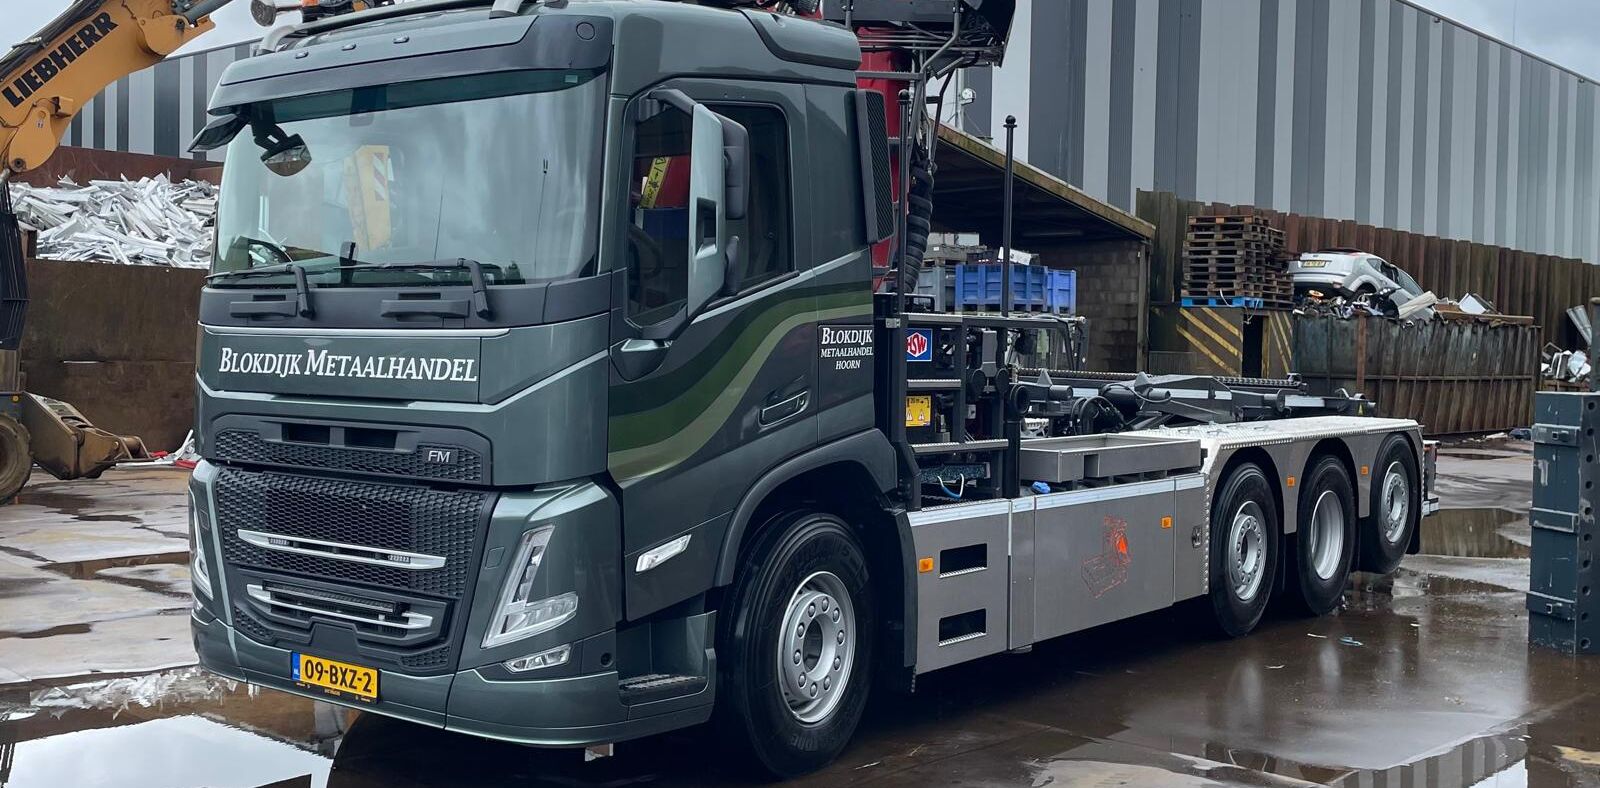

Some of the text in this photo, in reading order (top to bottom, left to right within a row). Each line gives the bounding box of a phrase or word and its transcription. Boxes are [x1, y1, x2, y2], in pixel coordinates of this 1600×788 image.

[1, 12, 119, 108] LIEBHERR
[821, 328, 873, 345] BLOKDIJK
[906, 334, 927, 355] HSW
[820, 347, 874, 358] METAALHANDEL
[219, 347, 477, 382] BLOKDIJK METAALHANDEL
[835, 359, 861, 370] HOORN
[428, 450, 450, 462] FM
[304, 660, 372, 693] 09-BXZ-2
